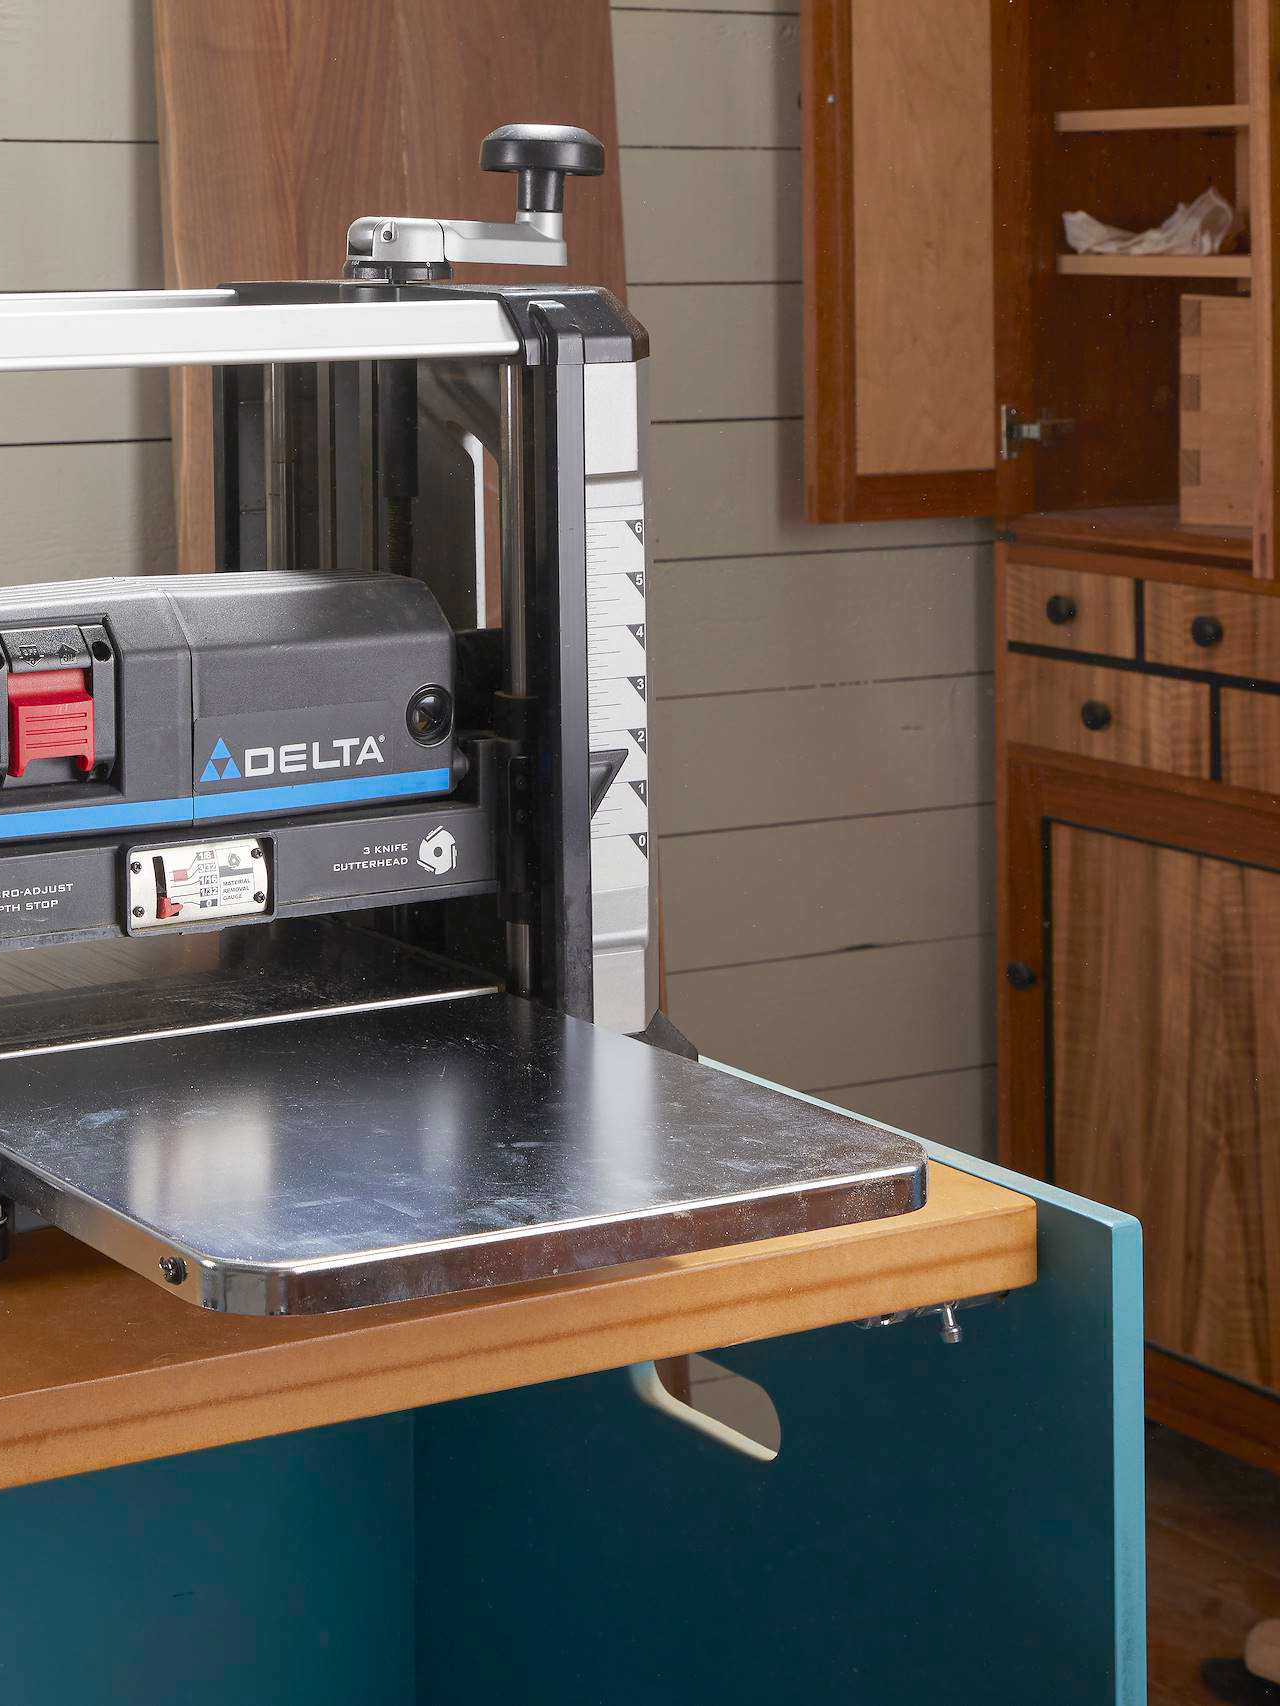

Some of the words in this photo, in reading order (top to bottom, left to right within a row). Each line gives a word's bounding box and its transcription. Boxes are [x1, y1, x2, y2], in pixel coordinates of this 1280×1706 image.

[634, 521, 643, 534] 6
[635, 573, 644, 586] 5
[635, 626, 644, 638] 4
[636, 678, 645, 690] 3
[637, 730, 646, 743] 2
[638, 782, 645, 795] 1
[638, 834, 646, 847] 0
[363, 847, 370, 855] 3
[375, 843, 408, 854] KNIFE
[333, 857, 408, 872] CUTTERHEAD
[222, 878, 251, 886] MATERIAL
[222, 886, 250, 894] REMOVAL
[25, 899, 59, 911] STOP
